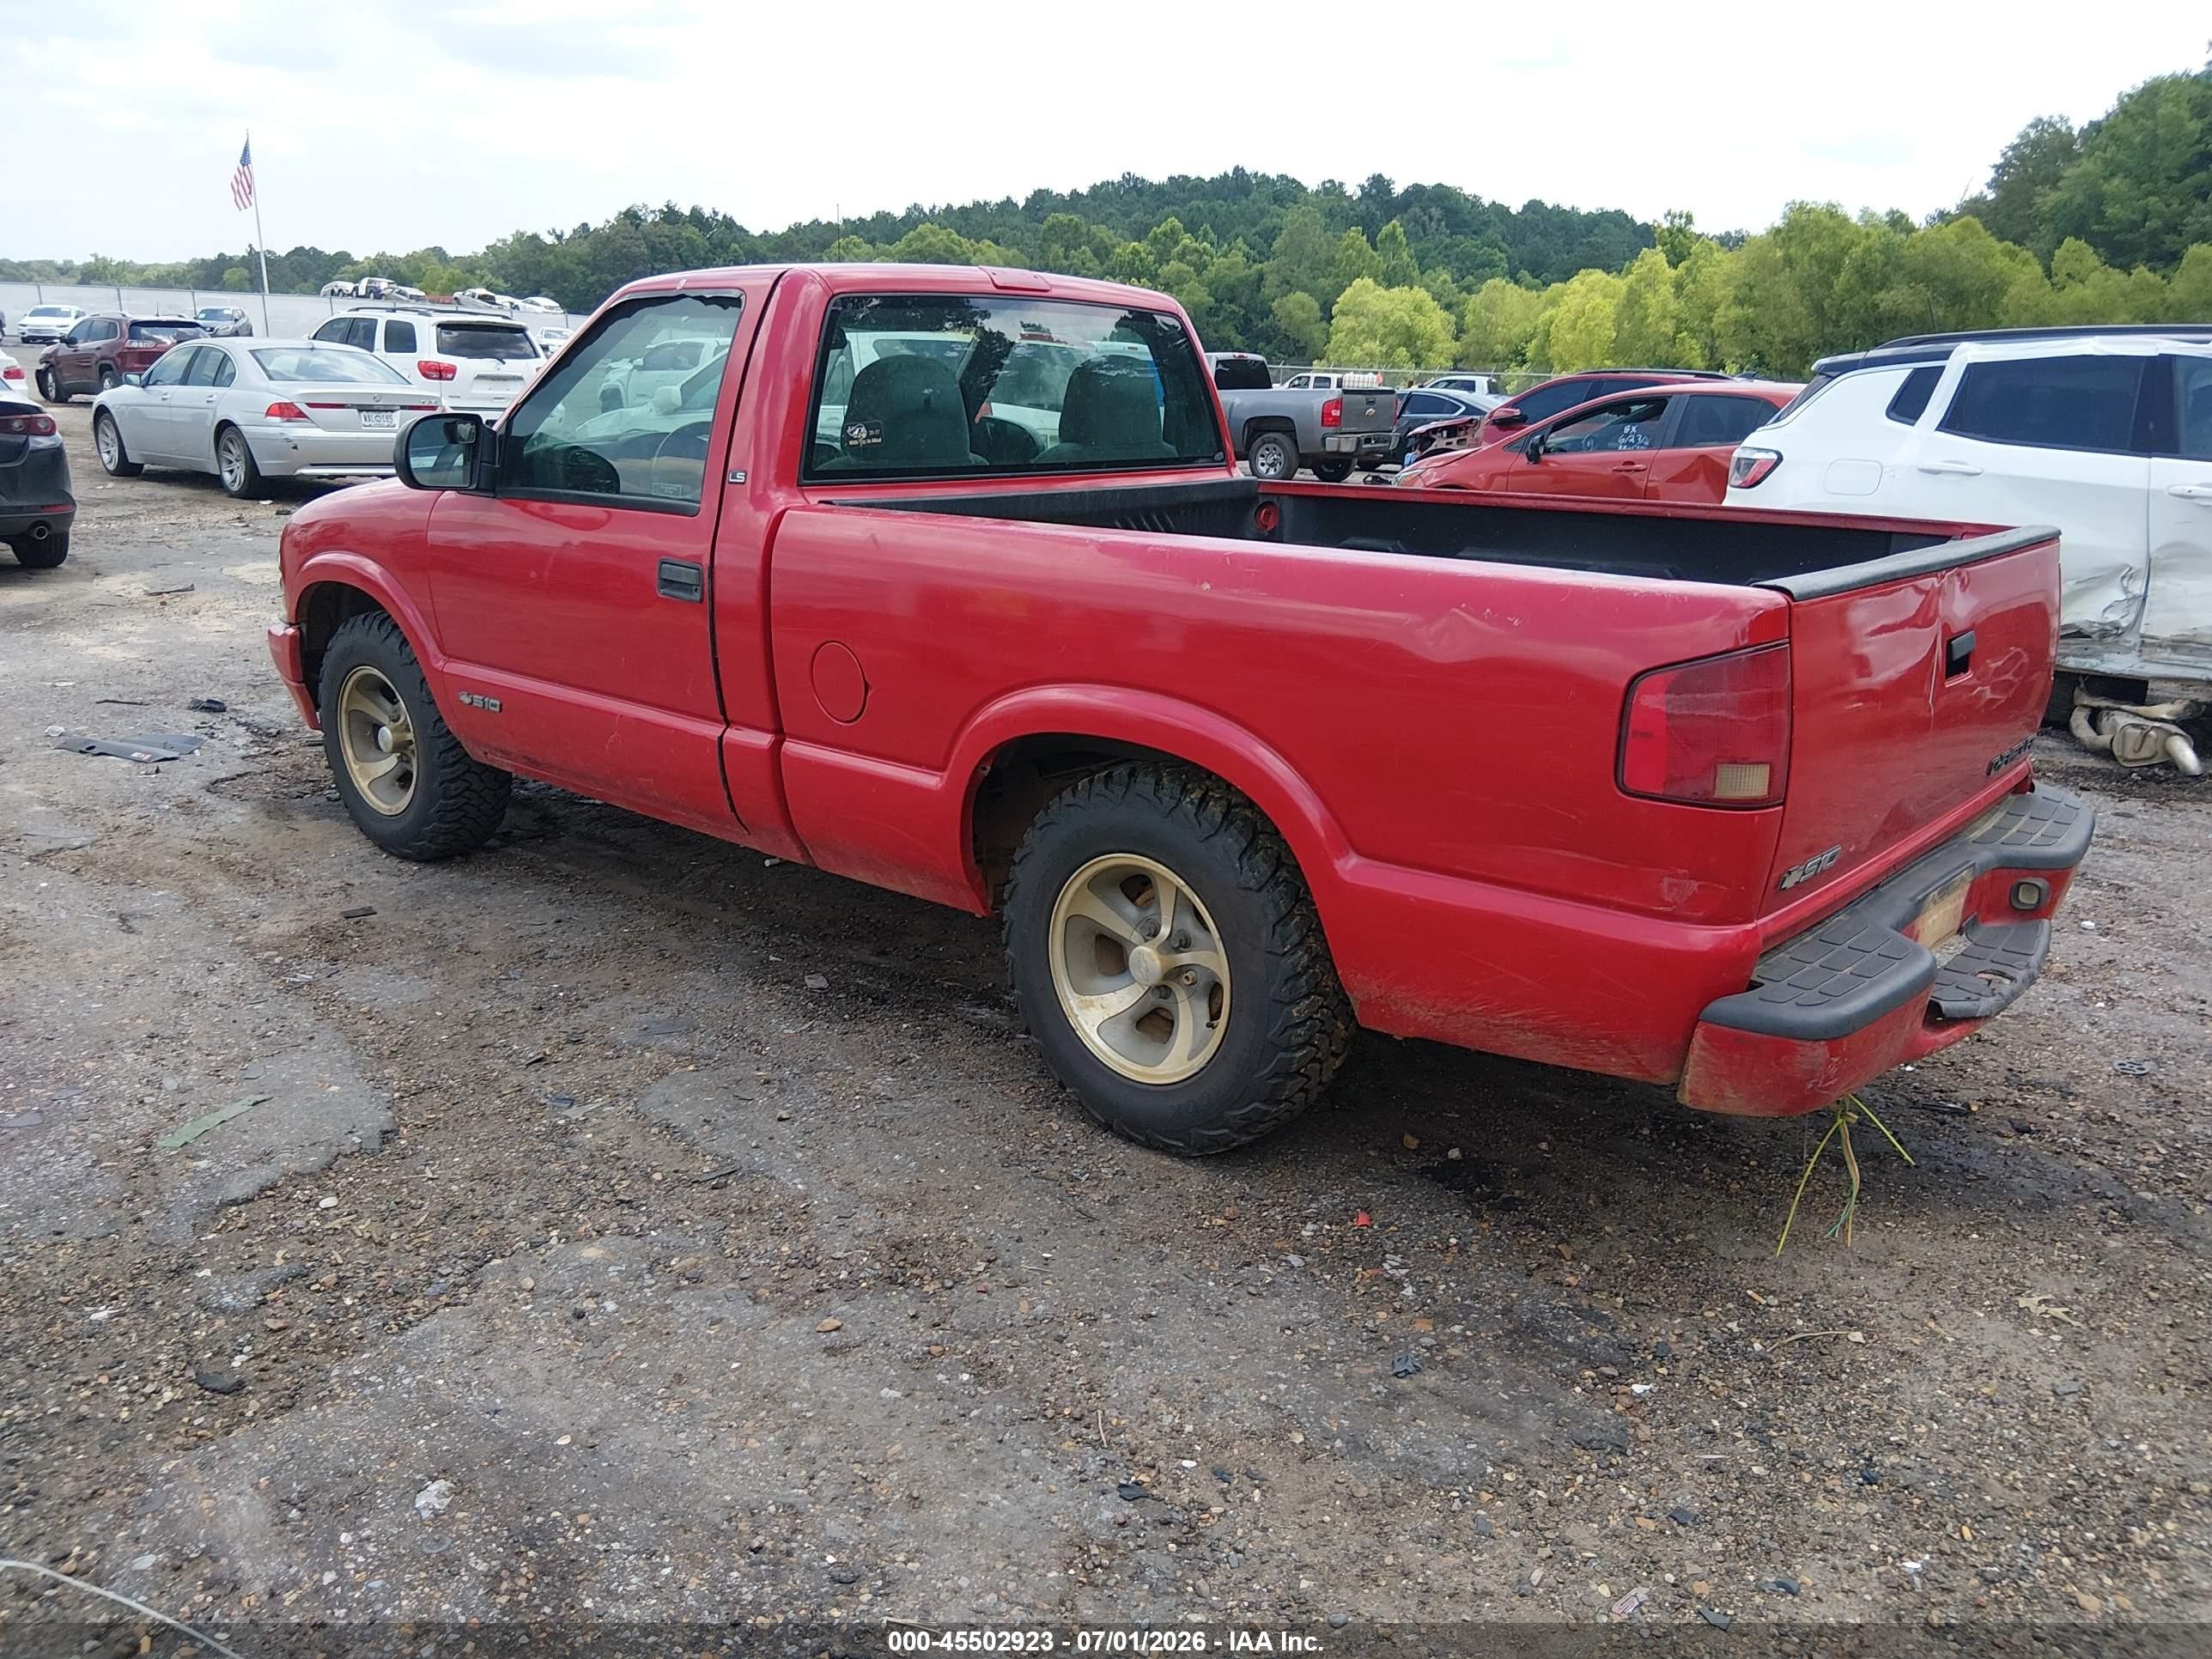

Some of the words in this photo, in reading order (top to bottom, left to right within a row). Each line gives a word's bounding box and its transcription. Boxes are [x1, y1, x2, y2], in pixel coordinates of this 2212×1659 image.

[729, 471, 746, 483] LS
[472, 694, 501, 713] S10
[1800, 846, 1841, 884] S10
